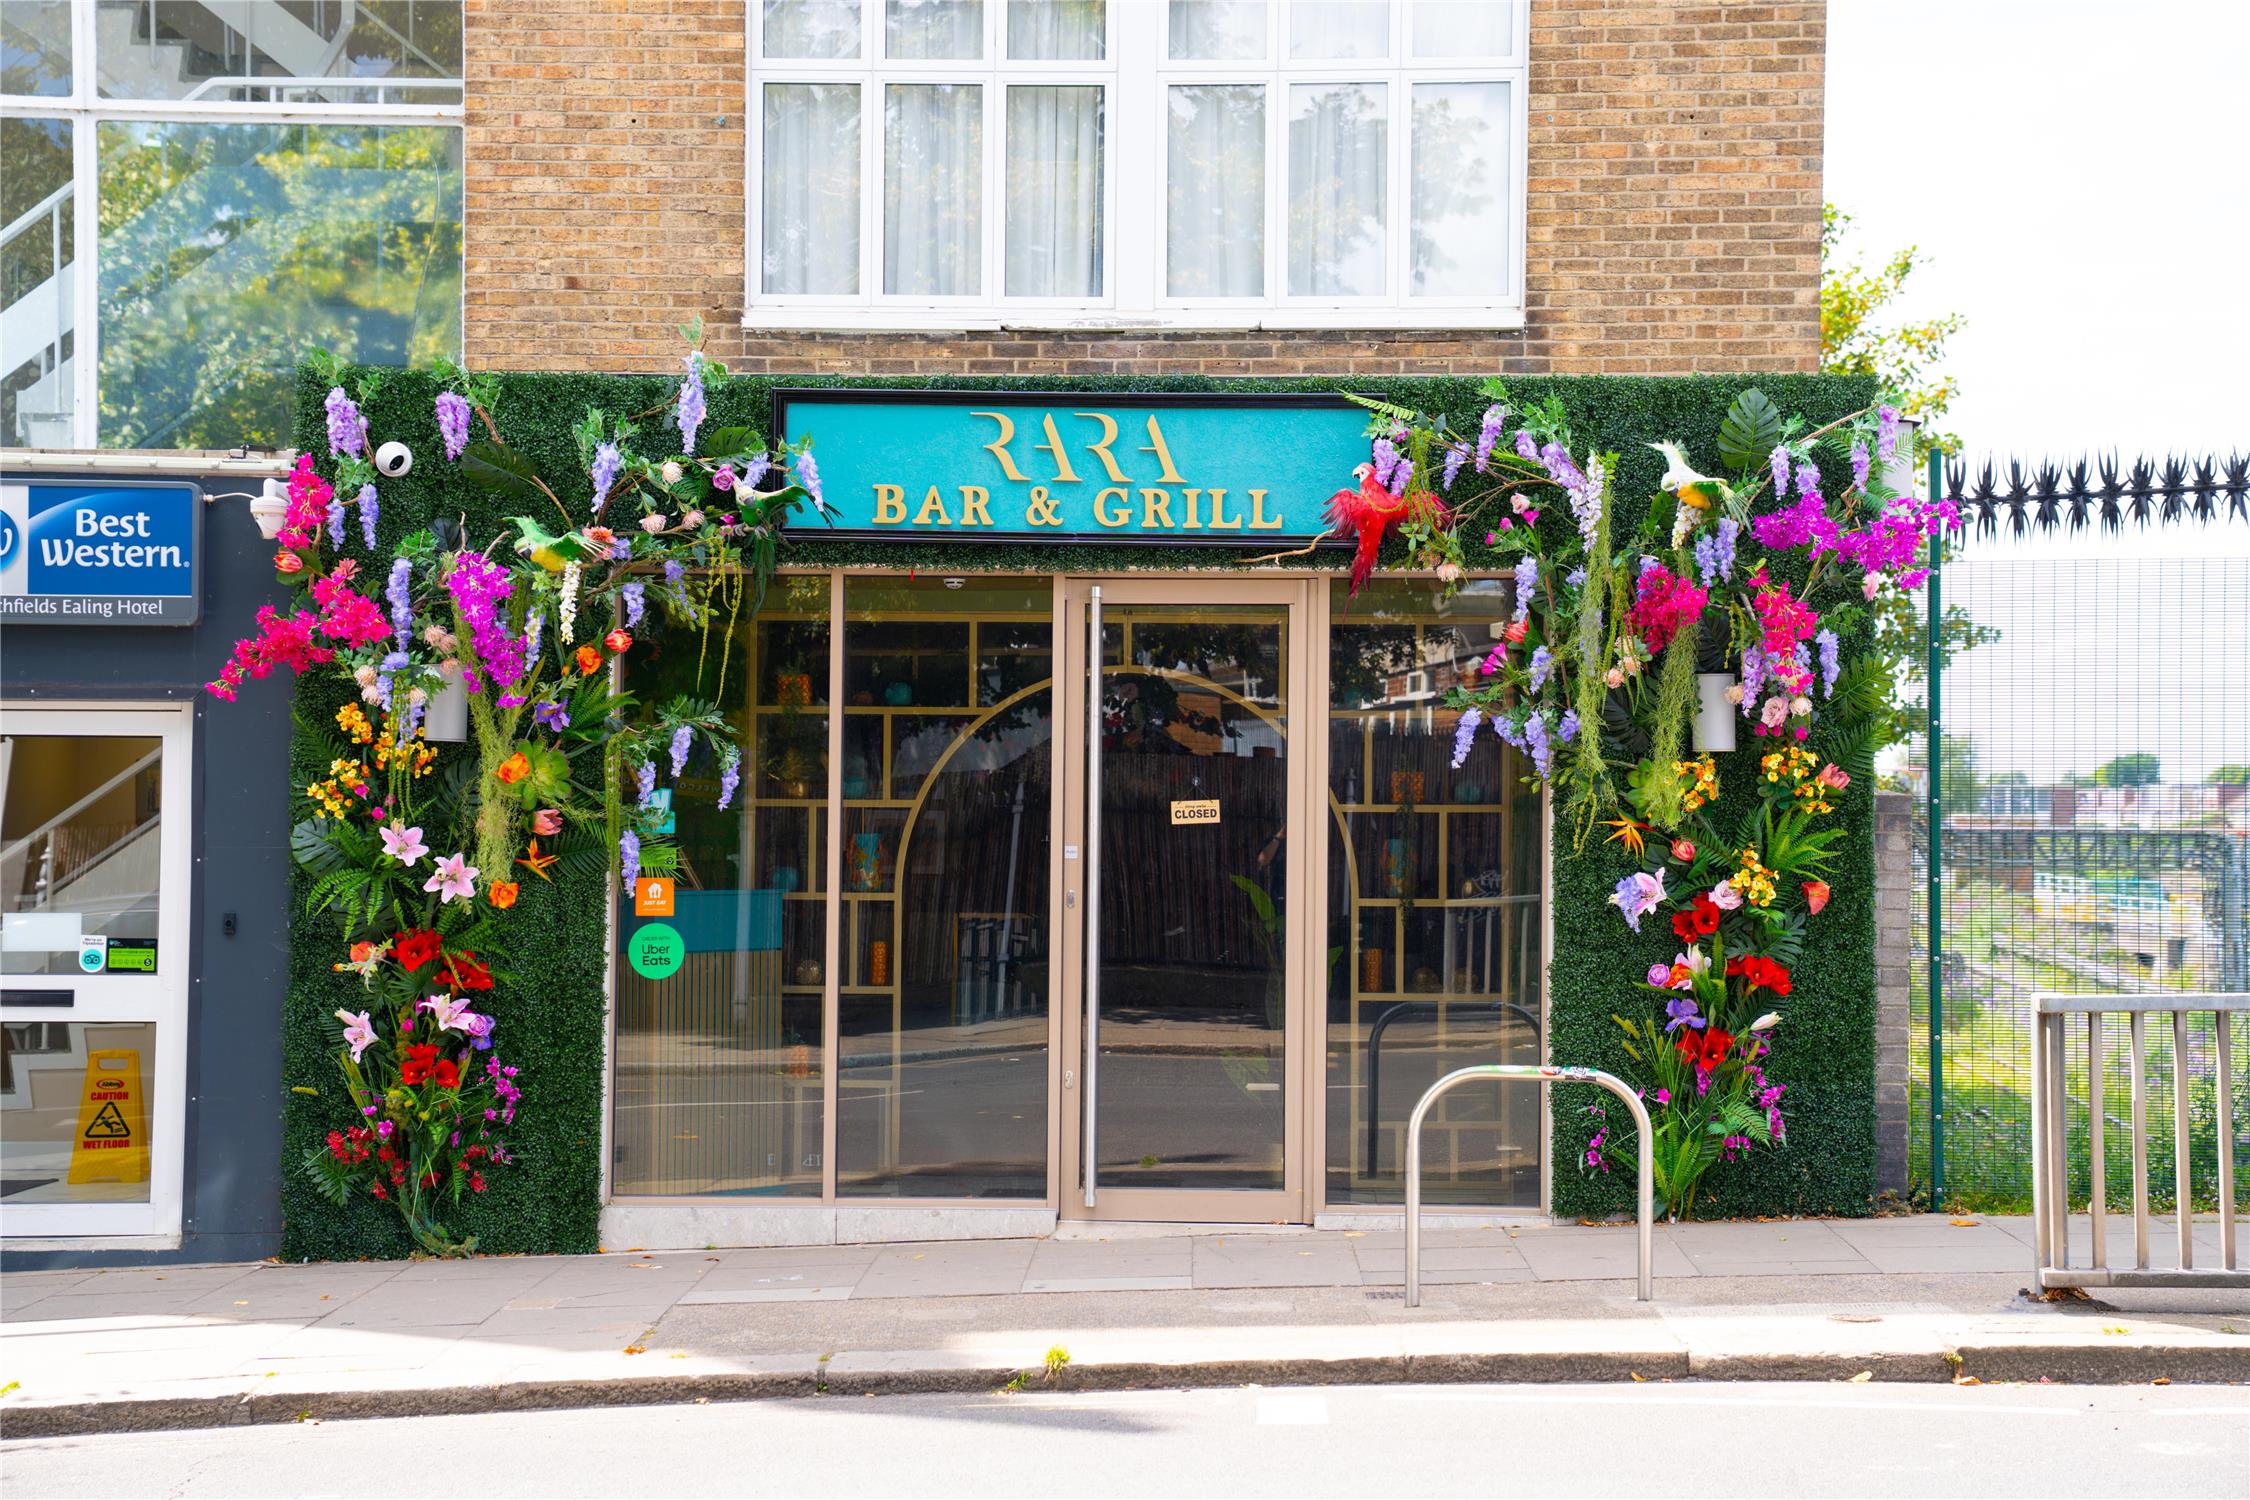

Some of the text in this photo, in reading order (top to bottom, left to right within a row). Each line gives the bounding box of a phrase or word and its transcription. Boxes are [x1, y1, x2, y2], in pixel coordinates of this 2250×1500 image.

[970, 411, 1187, 483] RARA
[871, 484, 1283, 530] BAR & GRILL
[75, 508, 151, 538] Best
[40, 538, 182, 568] Western
[62, 599, 113, 617] Ealing
[117, 600, 163, 615] Hotel
[1174, 809, 1217, 819] CLOSED
[641, 944, 670, 955] Uber
[642, 955, 671, 966] Eats
[91, 1091, 128, 1100] CAUTION
[82, 1139, 130, 1149] WET FLOOR
